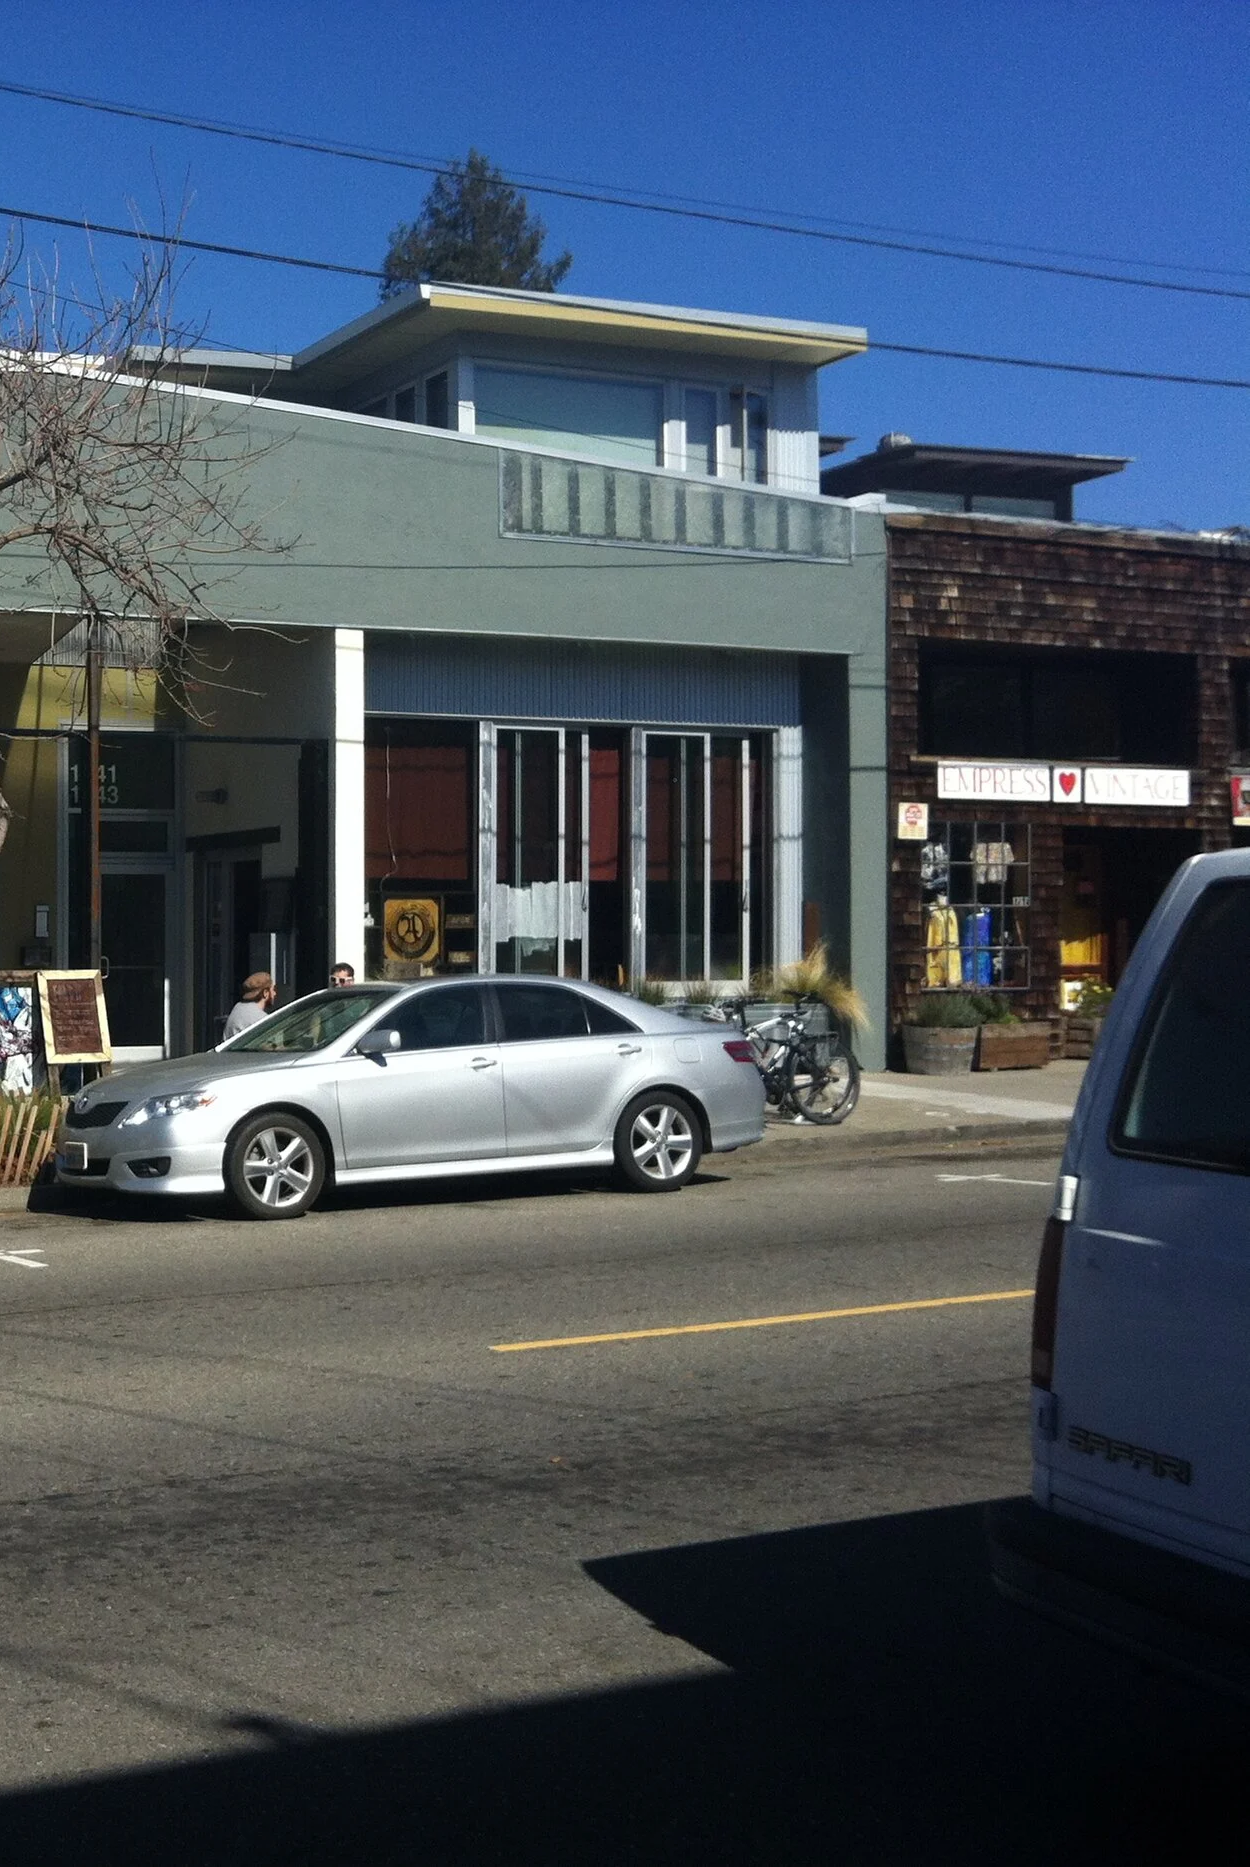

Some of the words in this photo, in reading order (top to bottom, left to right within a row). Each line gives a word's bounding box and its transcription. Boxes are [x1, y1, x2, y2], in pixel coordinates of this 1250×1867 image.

[70, 764, 116, 783] 141
[942, 767, 1047, 796] EMPRESS
[1088, 772, 1185, 800] VINTAGE
[70, 785, 118, 804] 143
